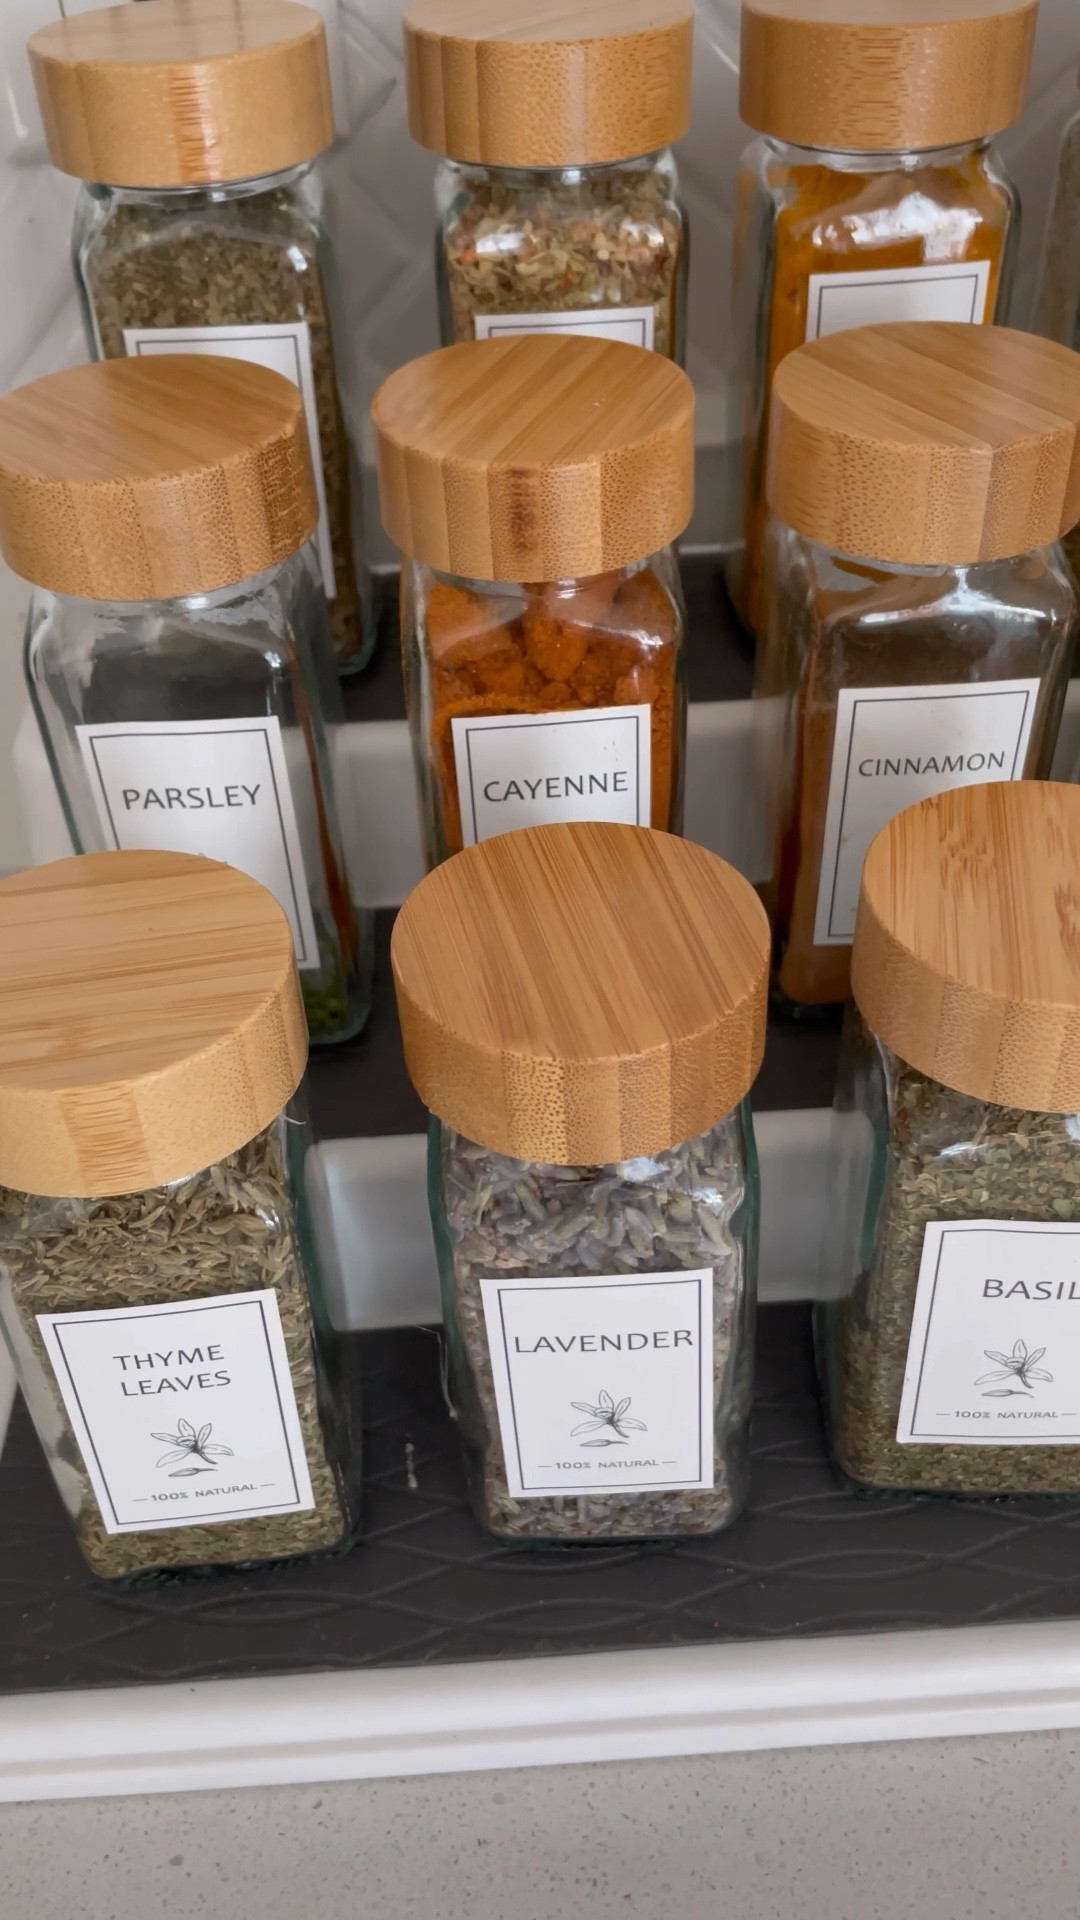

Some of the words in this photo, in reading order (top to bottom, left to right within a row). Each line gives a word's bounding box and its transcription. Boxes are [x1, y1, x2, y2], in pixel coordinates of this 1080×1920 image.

[857, 751, 1006, 777] CINNAMON
[121, 783, 261, 811] PARSLEY
[484, 770, 629, 804] CAYENNE
[982, 1278, 1080, 1301] BASIL
[514, 1329, 694, 1353] LAVENDER
[112, 1344, 226, 1371] THYME
[120, 1370, 232, 1397] LEAVES
[954, 1410, 991, 1419] 100%
[997, 1410, 1059, 1420] NATURAL
[555, 1461, 592, 1470] 100%
[598, 1458, 660, 1469] NATURAL
[151, 1491, 189, 1502] 100%
[194, 1483, 258, 1498] NATURAL
